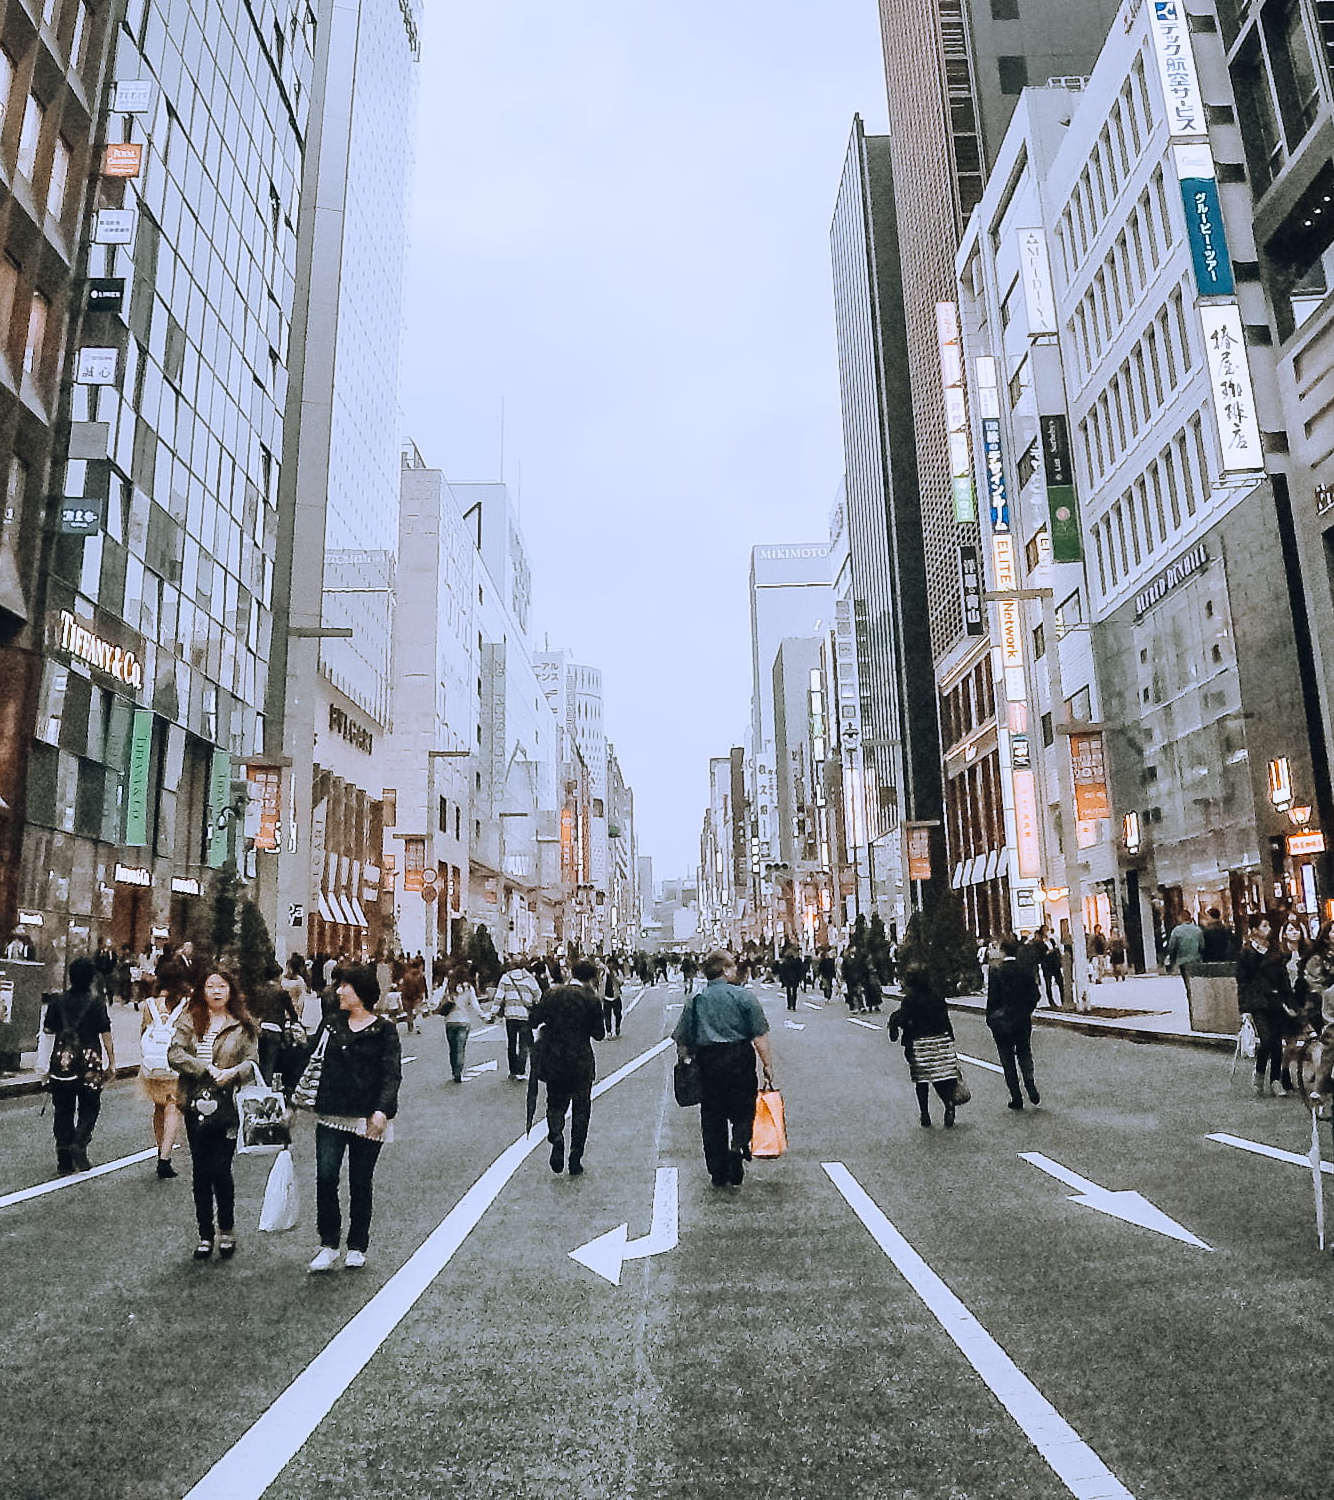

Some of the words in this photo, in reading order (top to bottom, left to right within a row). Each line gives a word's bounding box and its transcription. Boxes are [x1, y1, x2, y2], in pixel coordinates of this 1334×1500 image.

[1210, 325, 1249, 450] 椿屋珈琲店
[760, 548, 828, 560] MIKIMOTO
[995, 539, 1012, 584] ELITE
[60, 608, 115, 672] TIFFANY
[1002, 601, 1019, 659] Network
